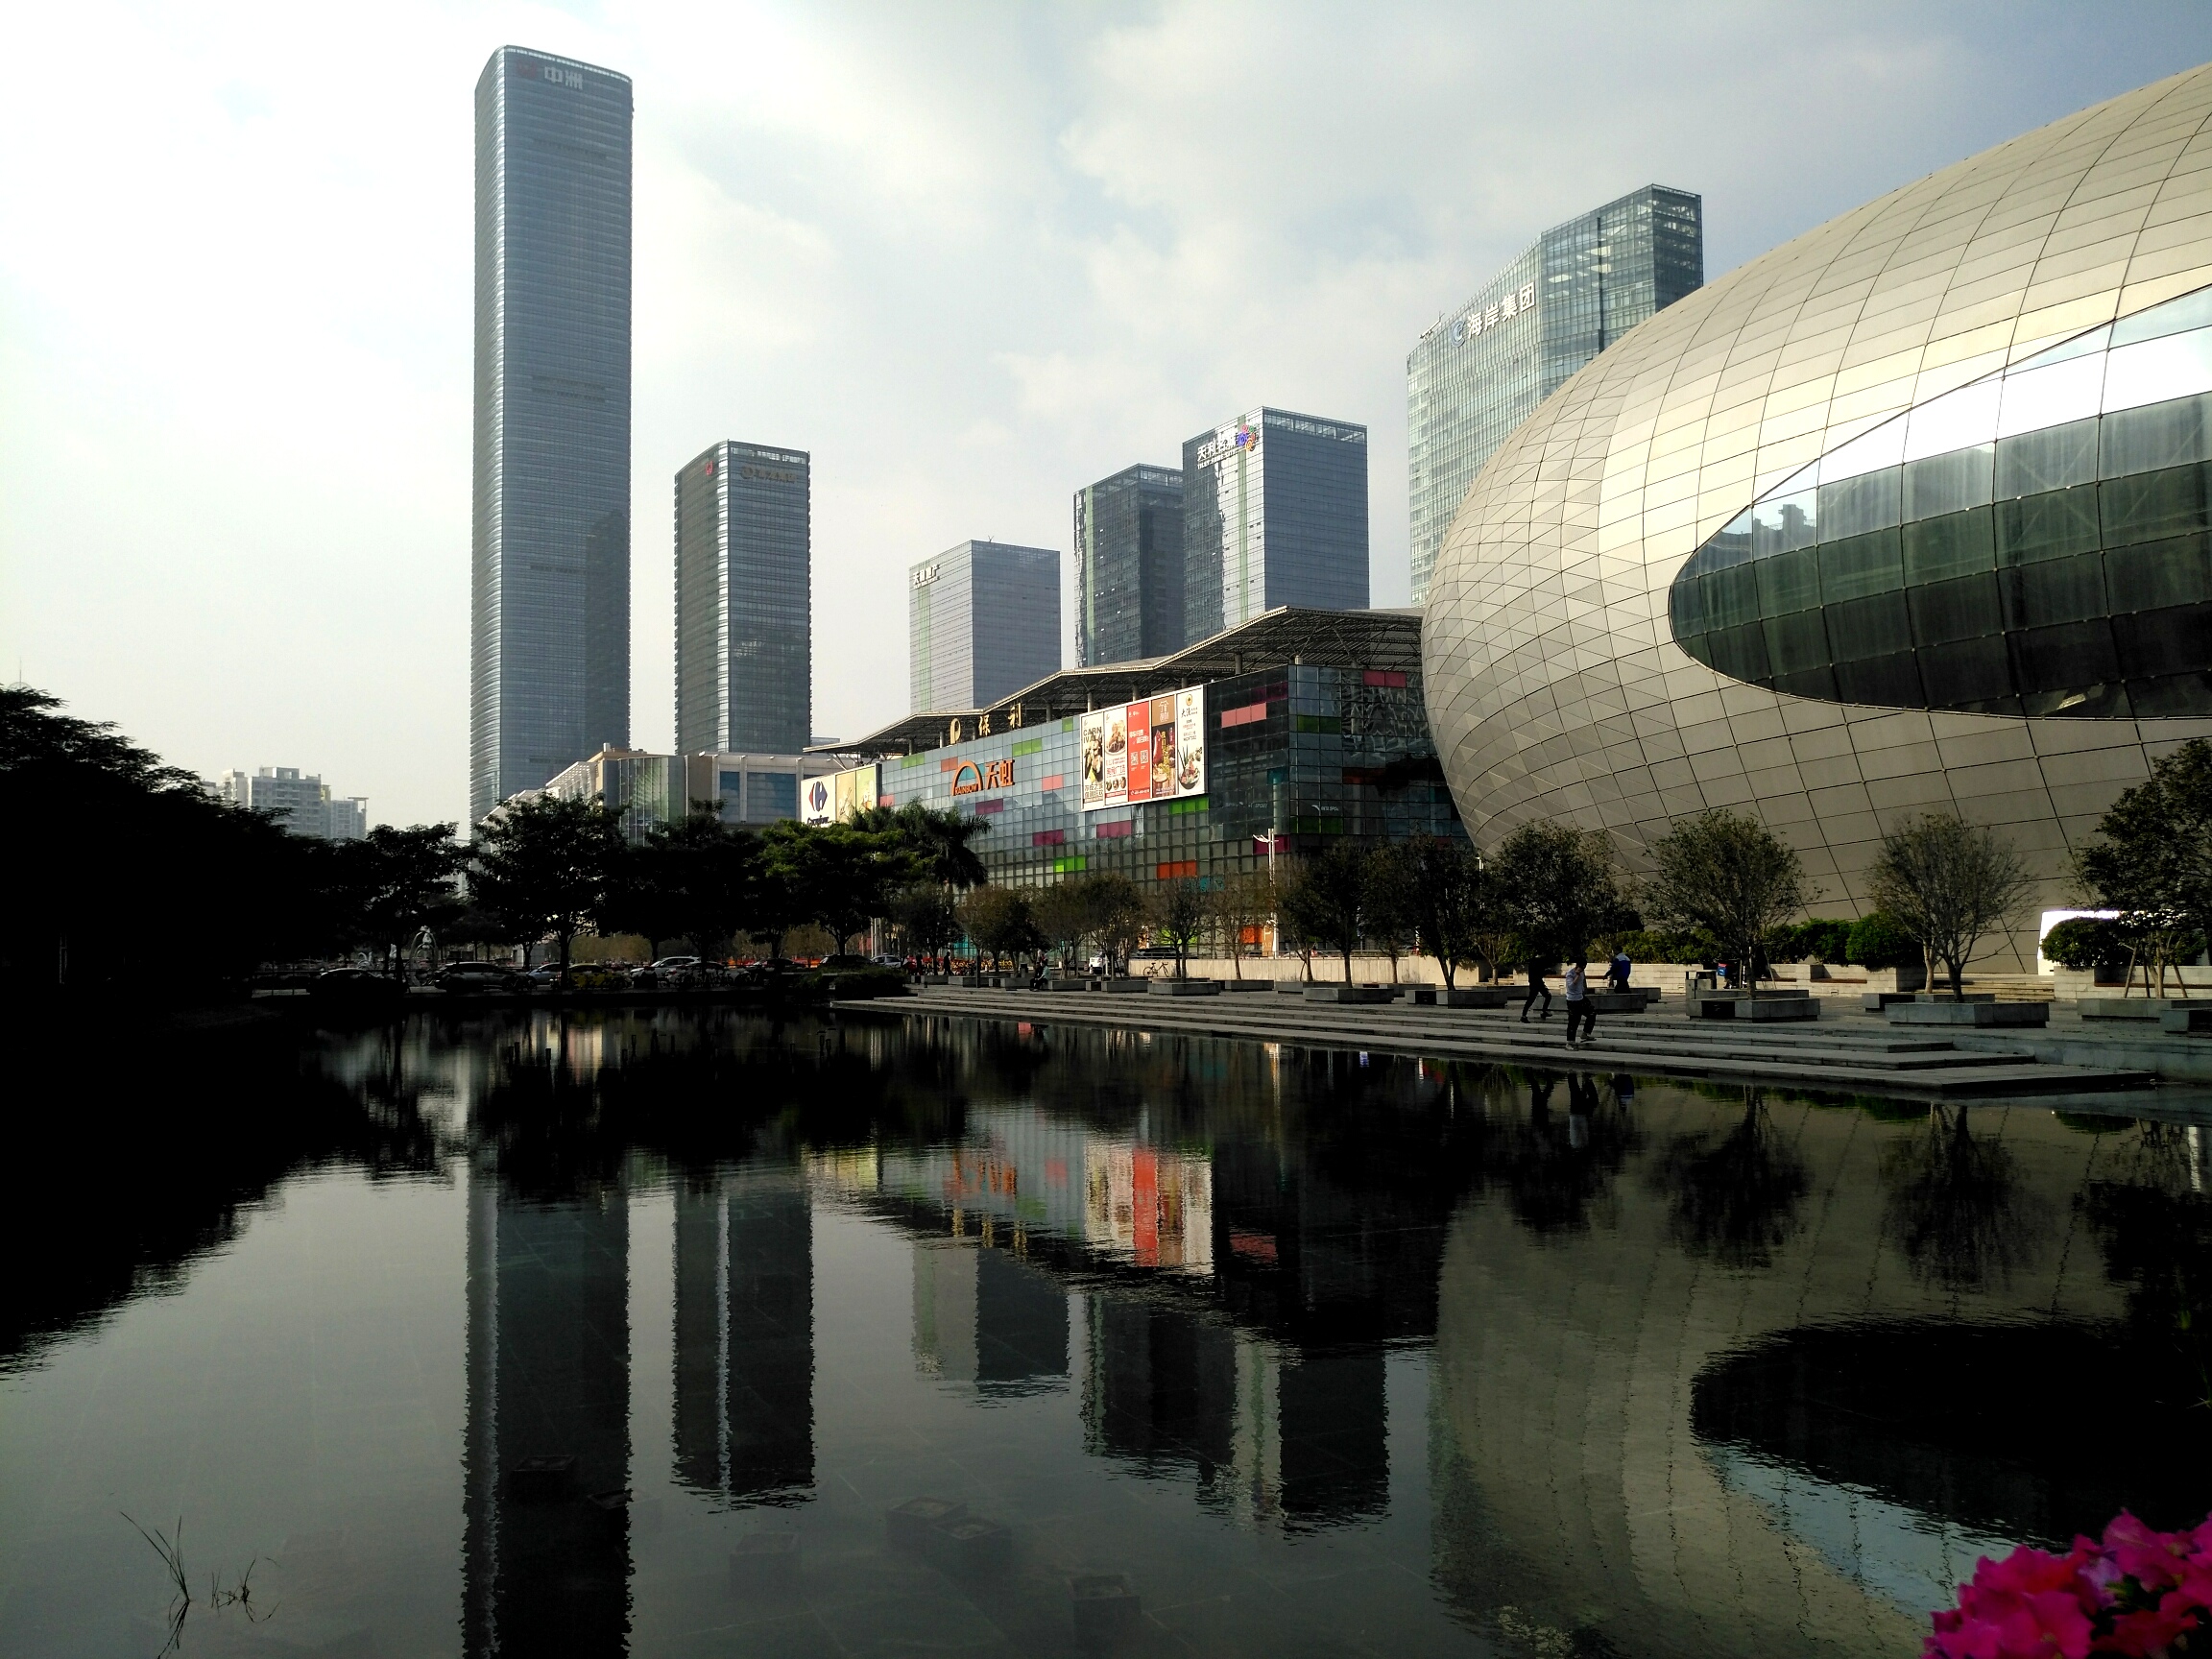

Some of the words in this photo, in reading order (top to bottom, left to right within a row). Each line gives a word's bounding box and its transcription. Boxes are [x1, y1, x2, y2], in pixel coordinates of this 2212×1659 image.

[544, 65, 584, 90] 中洲
[1467, 281, 1536, 339] 海岸集团
[978, 702, 1022, 736] 保利
[954, 783, 979, 796] RAINBOW
[985, 758, 1015, 790] 天虹
